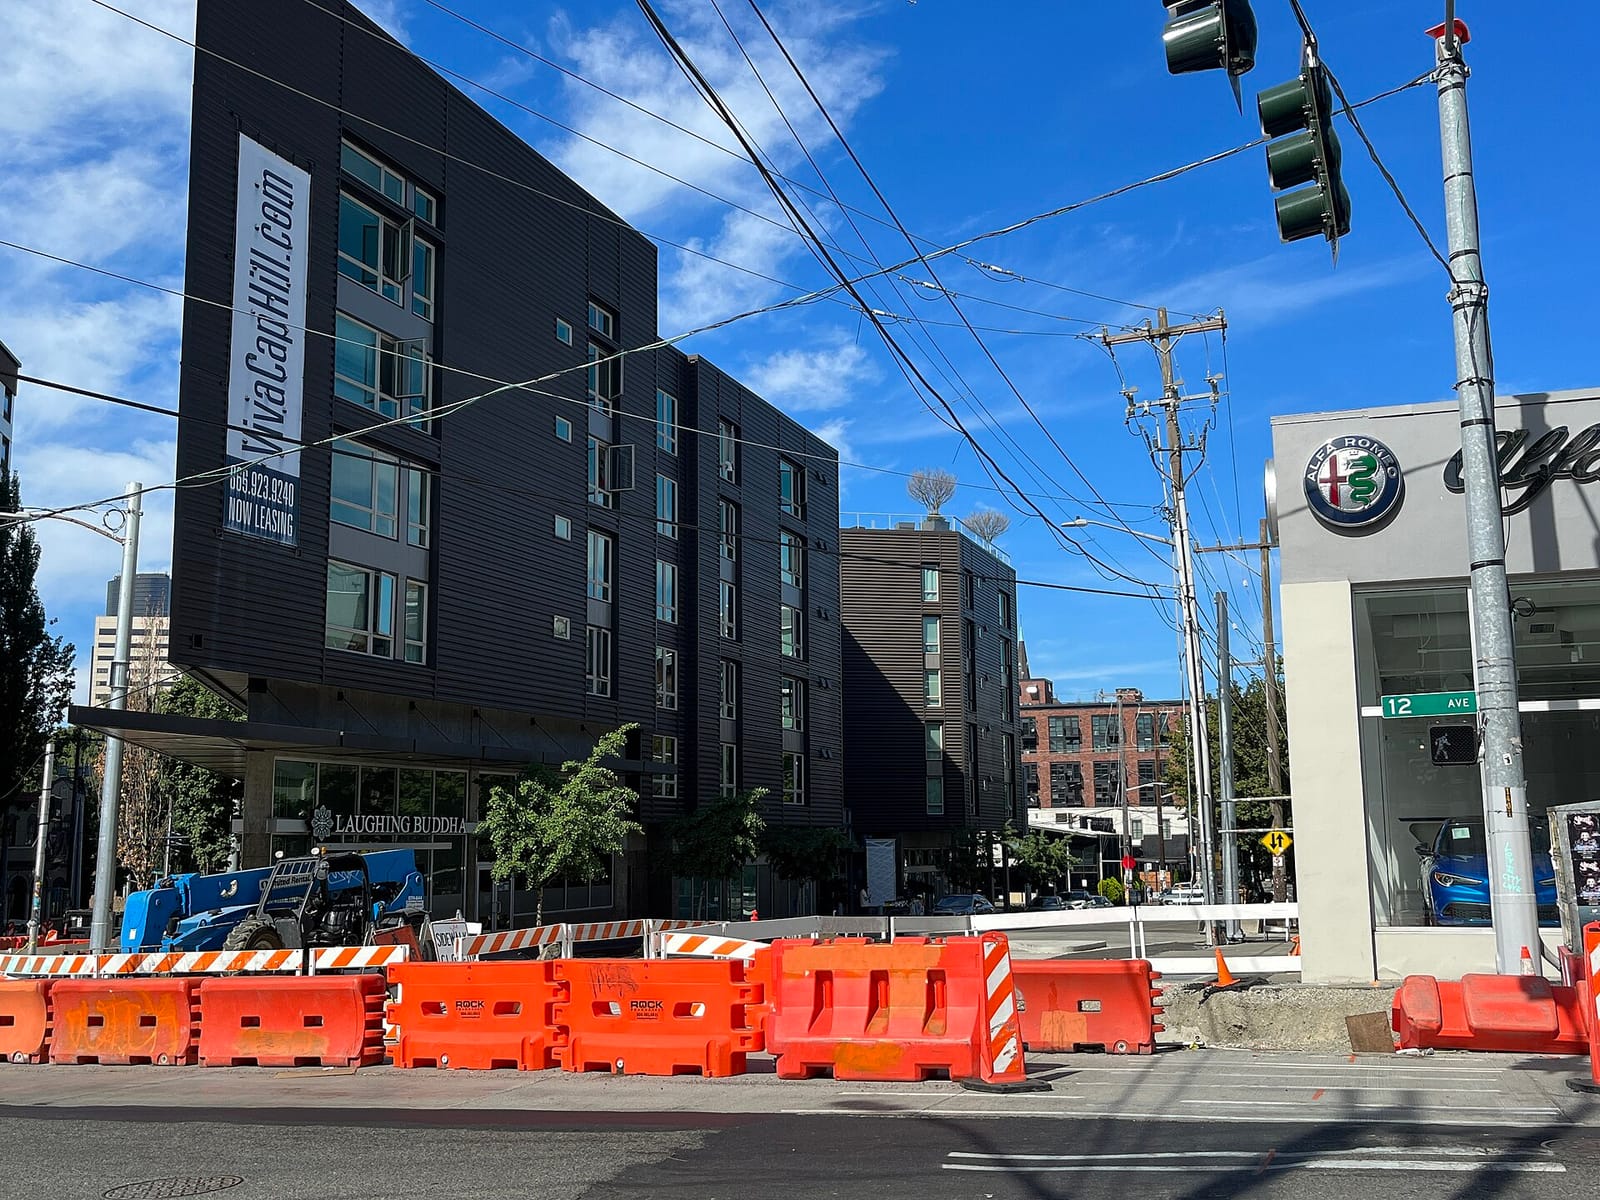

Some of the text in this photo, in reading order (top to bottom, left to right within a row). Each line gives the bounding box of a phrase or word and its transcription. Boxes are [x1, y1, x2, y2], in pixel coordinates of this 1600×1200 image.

[242, 169, 294, 456] VivaCapHill.com
[1307, 437, 1398, 482] ALFA ROMEO
[229, 496, 293, 537] NOW LEASING
[1388, 698, 1470, 715] 12 AVE
[335, 814, 466, 834] LAUGHING BUDDHA
[455, 1000, 485, 1008] ROCK
[630, 1000, 663, 1009] ROCK
